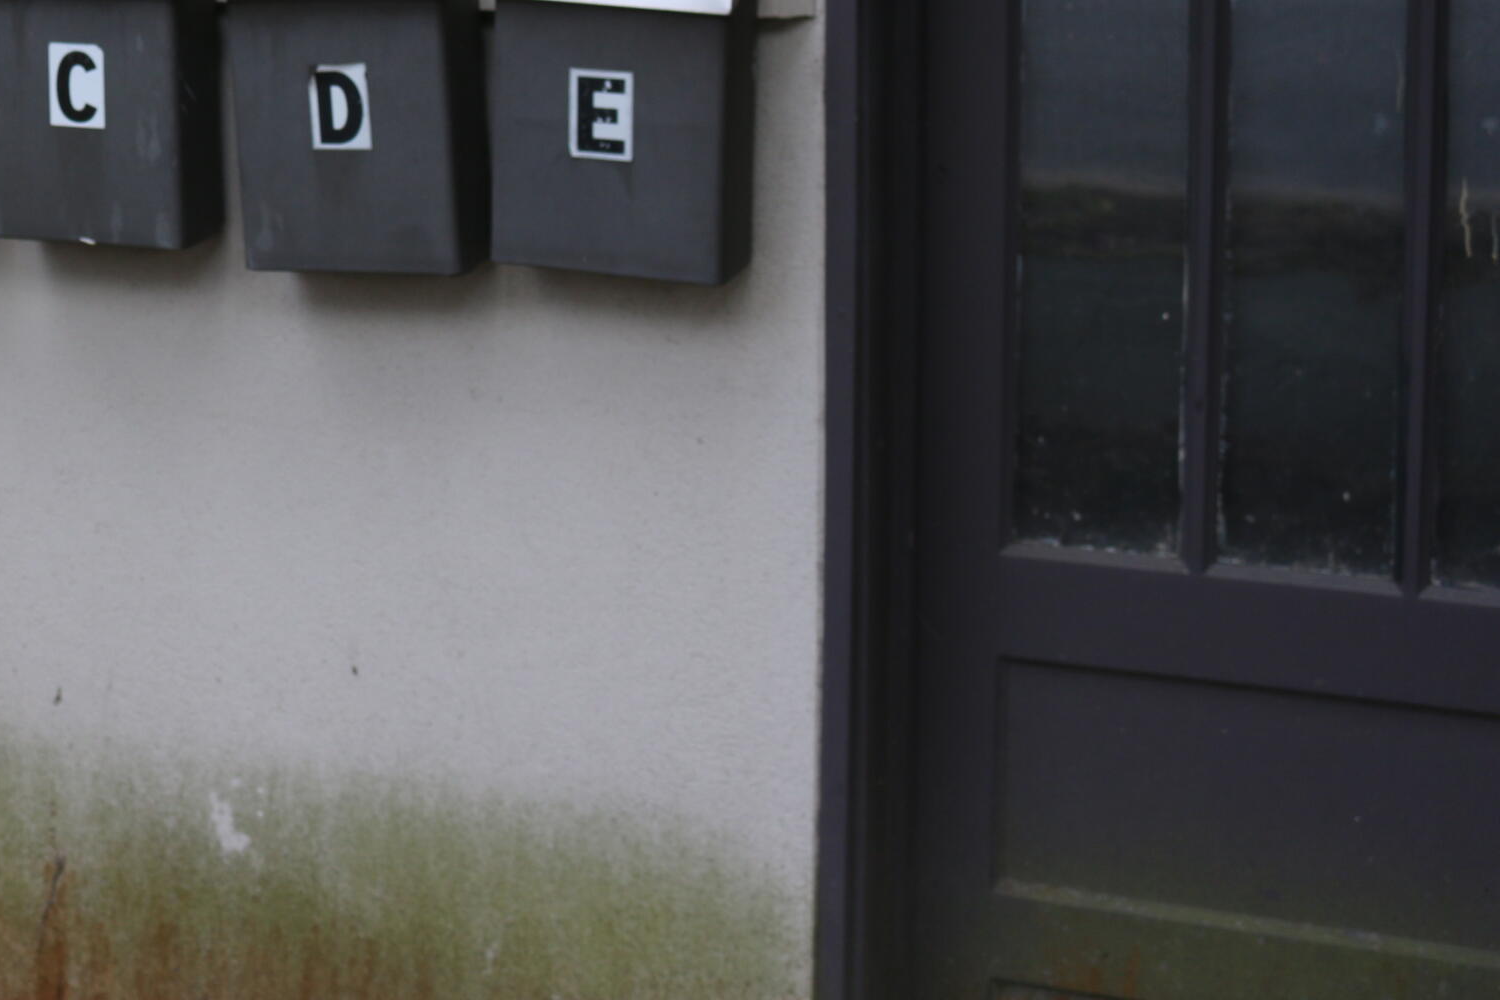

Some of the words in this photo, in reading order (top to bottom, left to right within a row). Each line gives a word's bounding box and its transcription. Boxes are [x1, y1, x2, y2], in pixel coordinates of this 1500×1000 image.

[56, 50, 98, 123] C
[315, 70, 363, 145] D
[577, 76, 626, 155] E
